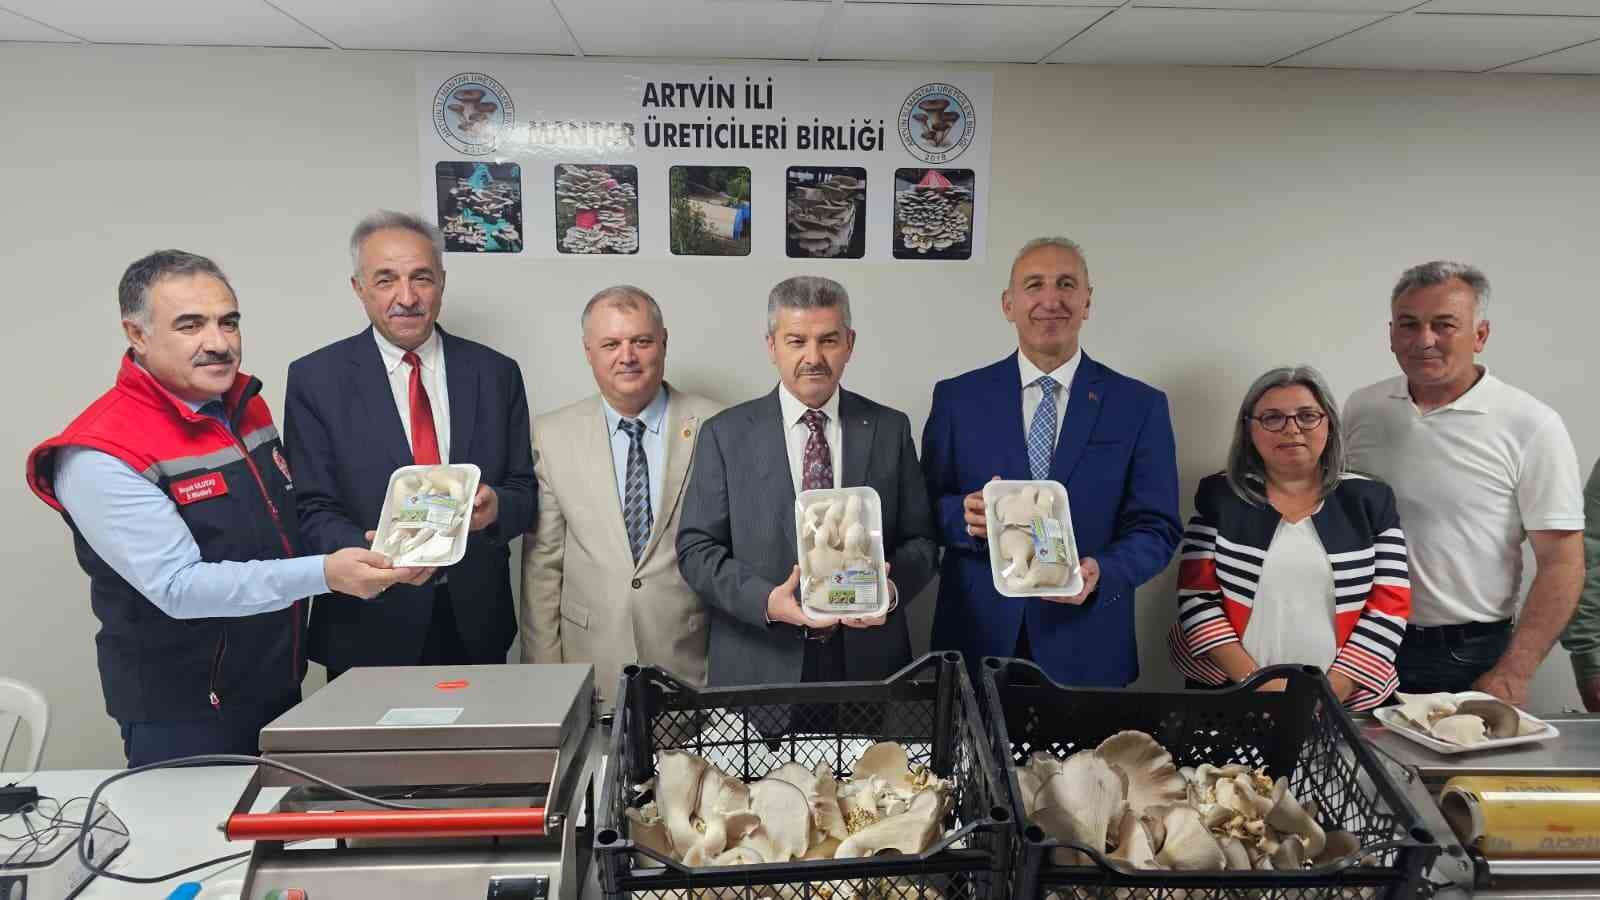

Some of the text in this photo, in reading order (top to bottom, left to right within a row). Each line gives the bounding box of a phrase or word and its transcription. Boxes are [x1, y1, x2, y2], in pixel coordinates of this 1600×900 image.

[642, 75, 773, 109] ARTVİN İLİ
[644, 115, 787, 149] ÜRETİCİLERİ
[797, 117, 884, 151] BİRLİĞİ
